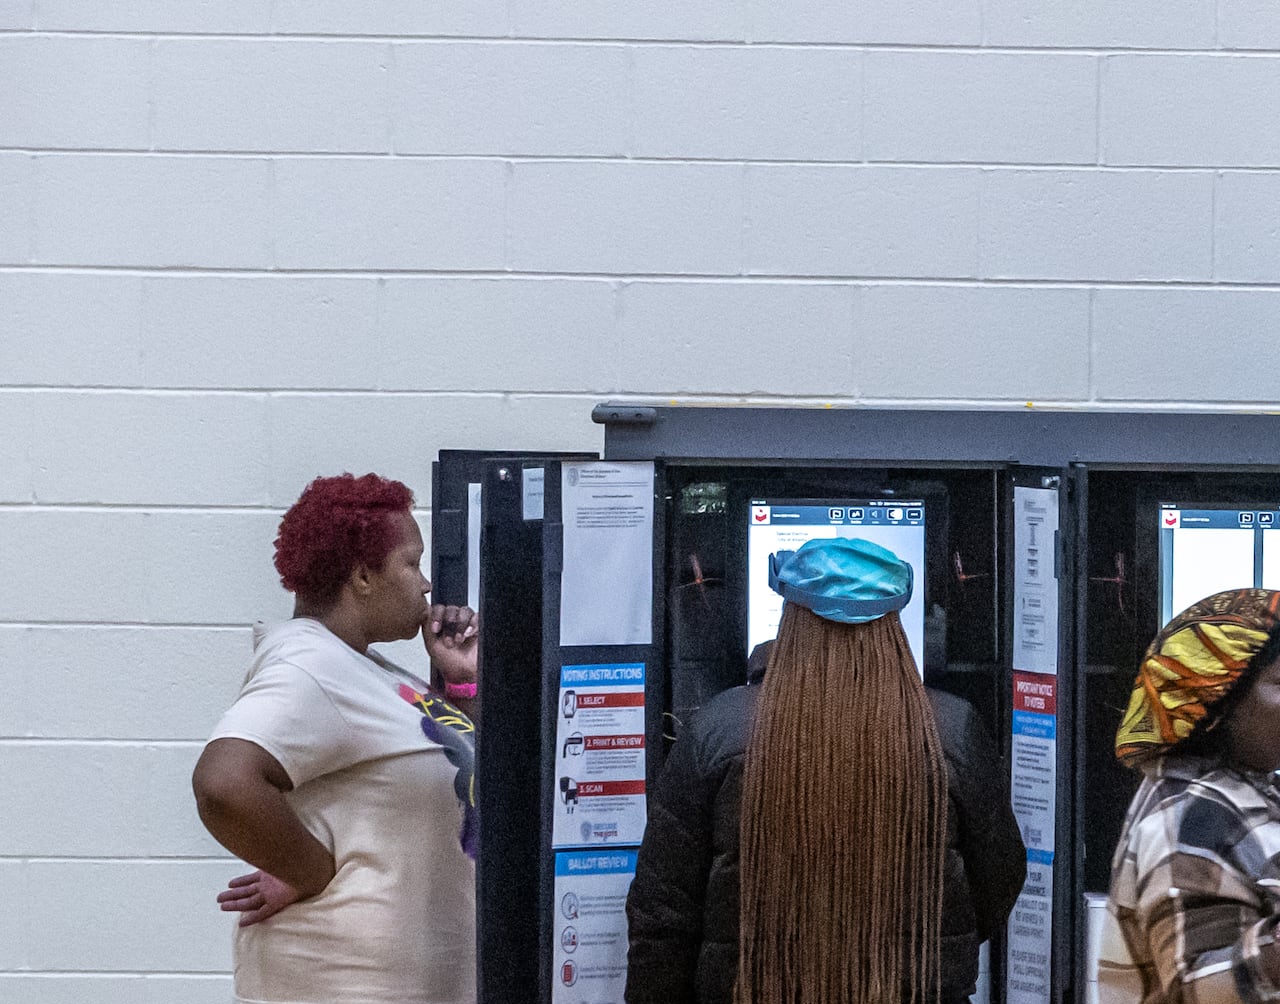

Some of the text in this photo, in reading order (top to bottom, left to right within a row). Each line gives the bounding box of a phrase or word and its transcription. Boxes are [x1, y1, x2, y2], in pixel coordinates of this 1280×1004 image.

[563, 668, 642, 682] VOTING INSTRUCTIONS
[583, 697, 605, 705] SELECT
[587, 739, 592, 747] 2.
[617, 738, 642, 746] REVIEW
[568, 856, 628, 870] BALLOT REVIEW
